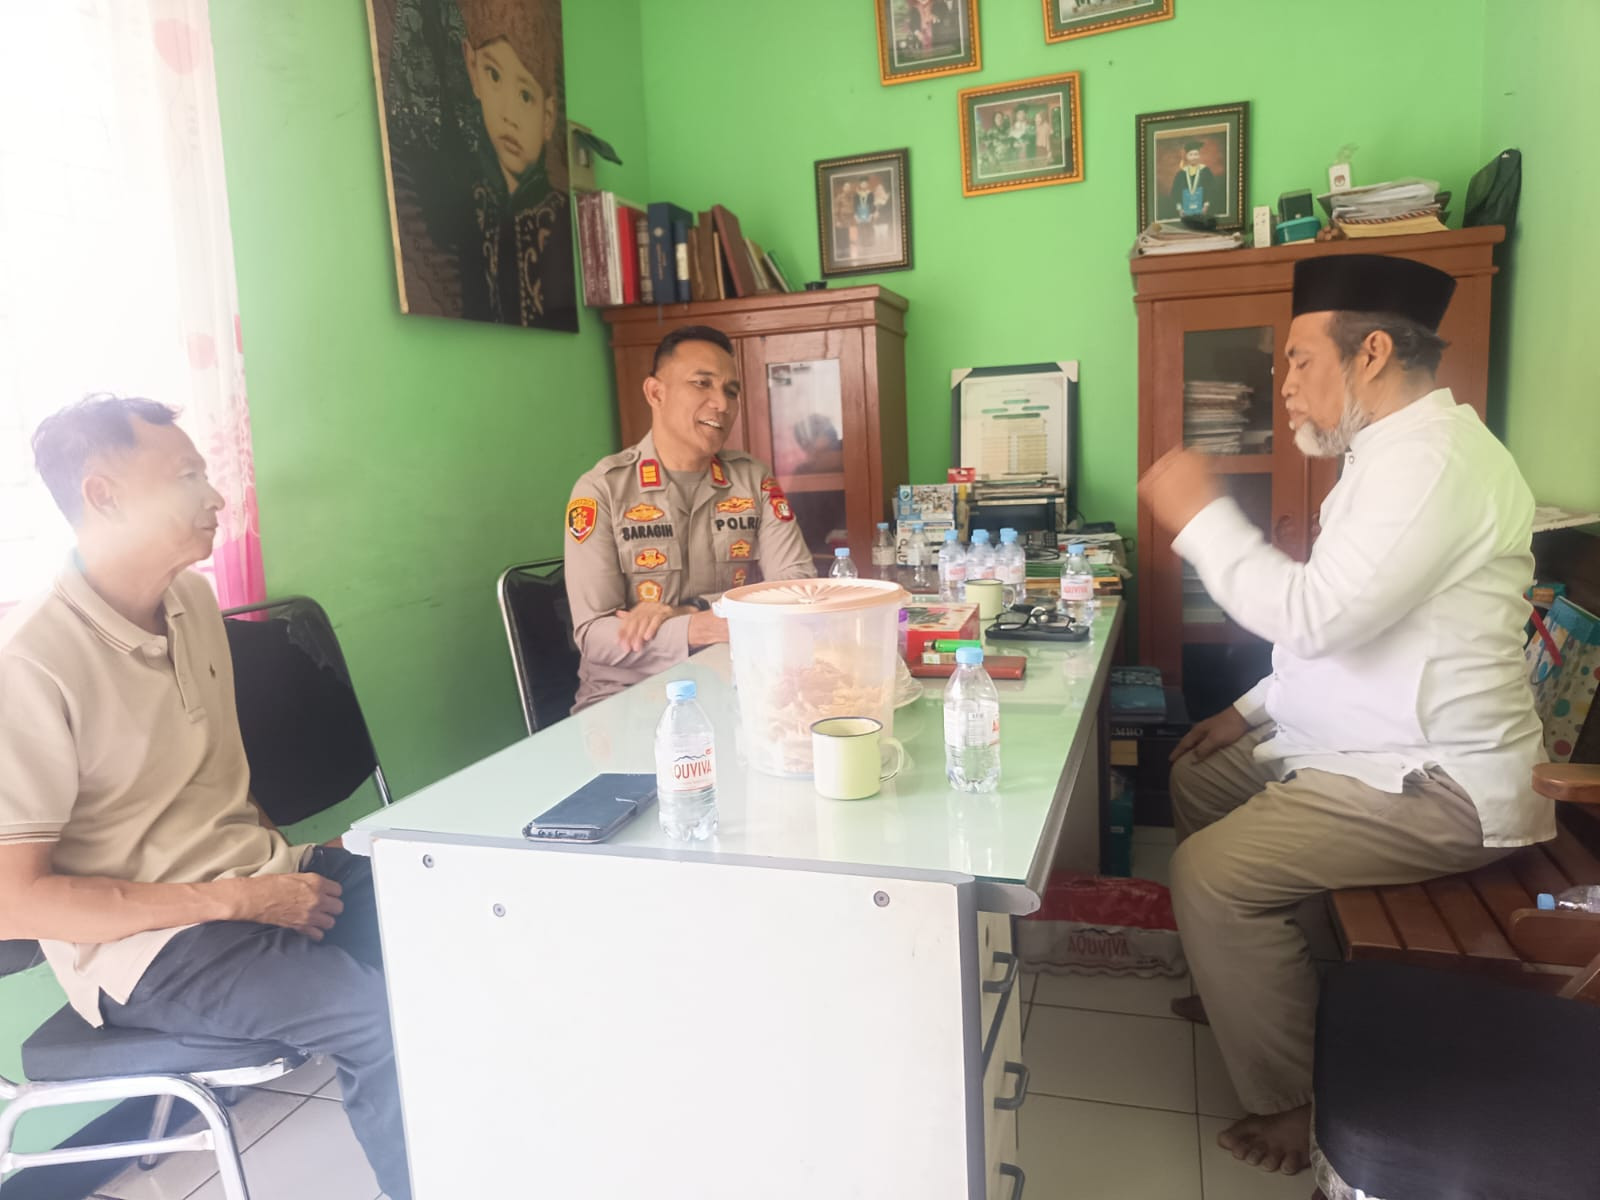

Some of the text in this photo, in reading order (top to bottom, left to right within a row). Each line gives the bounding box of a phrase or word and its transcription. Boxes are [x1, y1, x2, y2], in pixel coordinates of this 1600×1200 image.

[715, 516, 760, 531] POLRI
[622, 524, 673, 541] SARAGIH
[673, 760, 712, 779] QUVIVA
